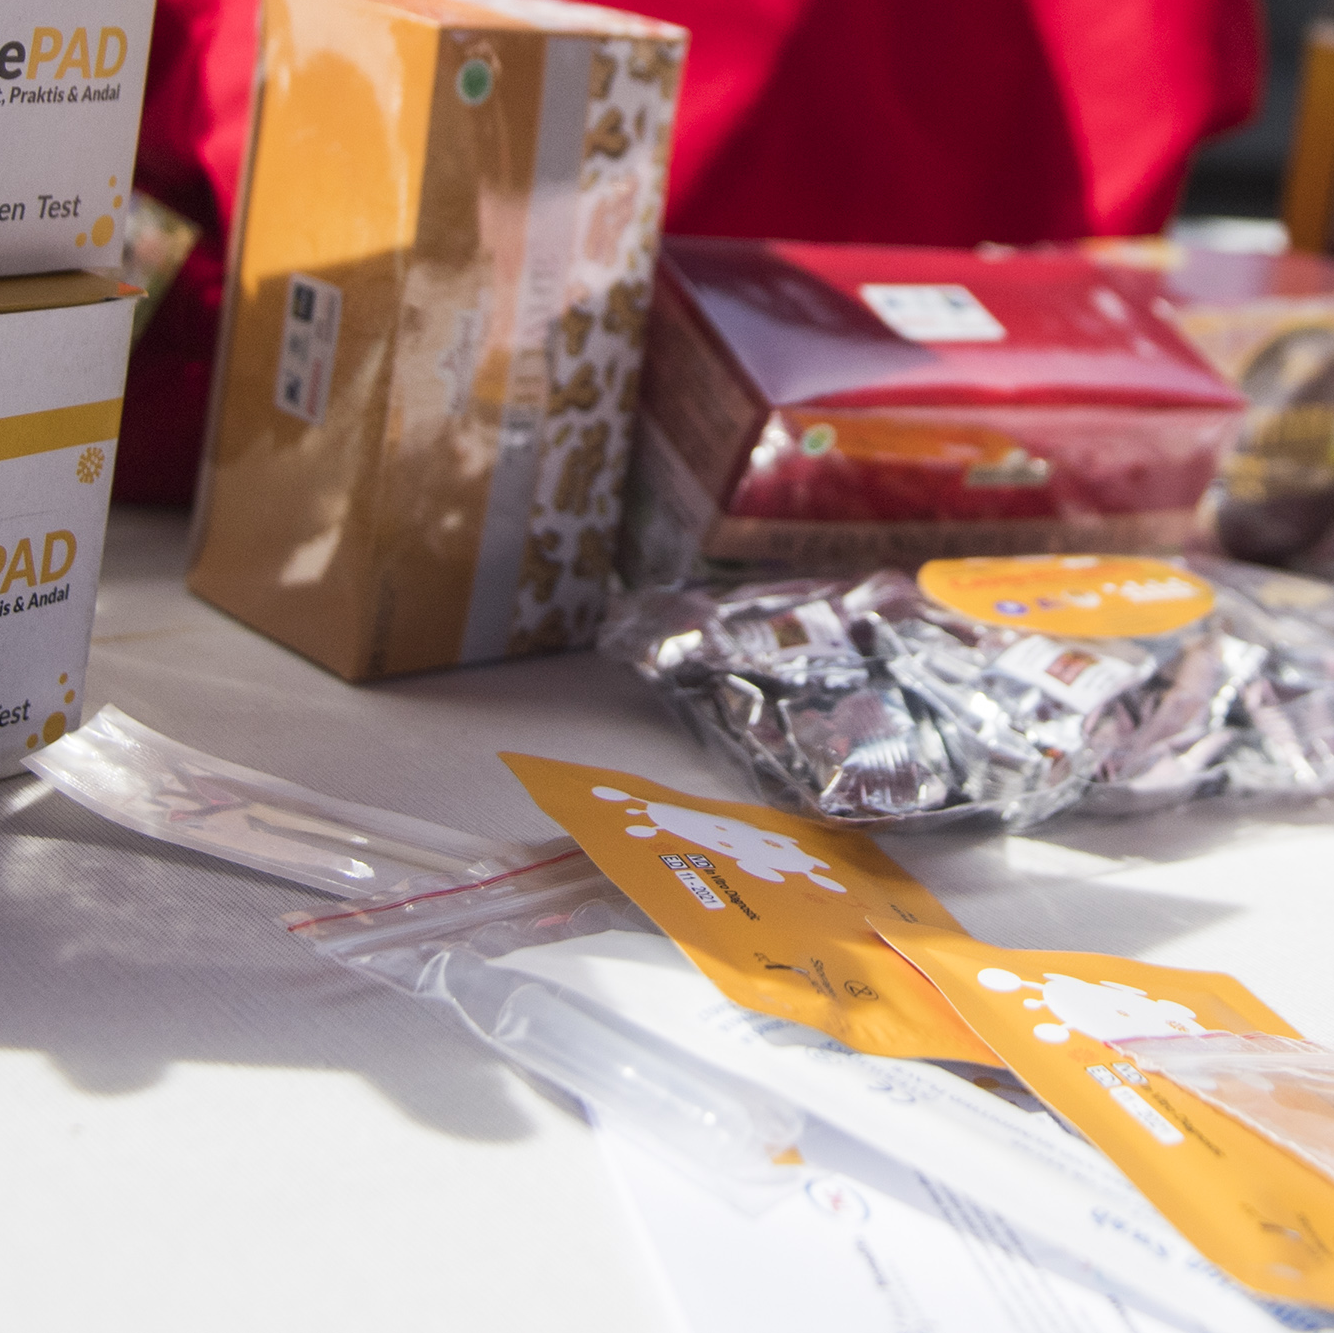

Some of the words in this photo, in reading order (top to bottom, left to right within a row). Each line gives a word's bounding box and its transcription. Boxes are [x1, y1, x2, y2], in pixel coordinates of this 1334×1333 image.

[9, 85, 65, 104] Praktis
[67, 85, 78, 103] &
[81, 83, 121, 102] Andal
[37, 195, 81, 219] Test
[13, 595, 24, 613] &
[27, 583, 70, 611] Andal
[663, 855, 686, 869] ED
[679, 871, 694, 883] 11
[692, 883, 718, 906] 2021
